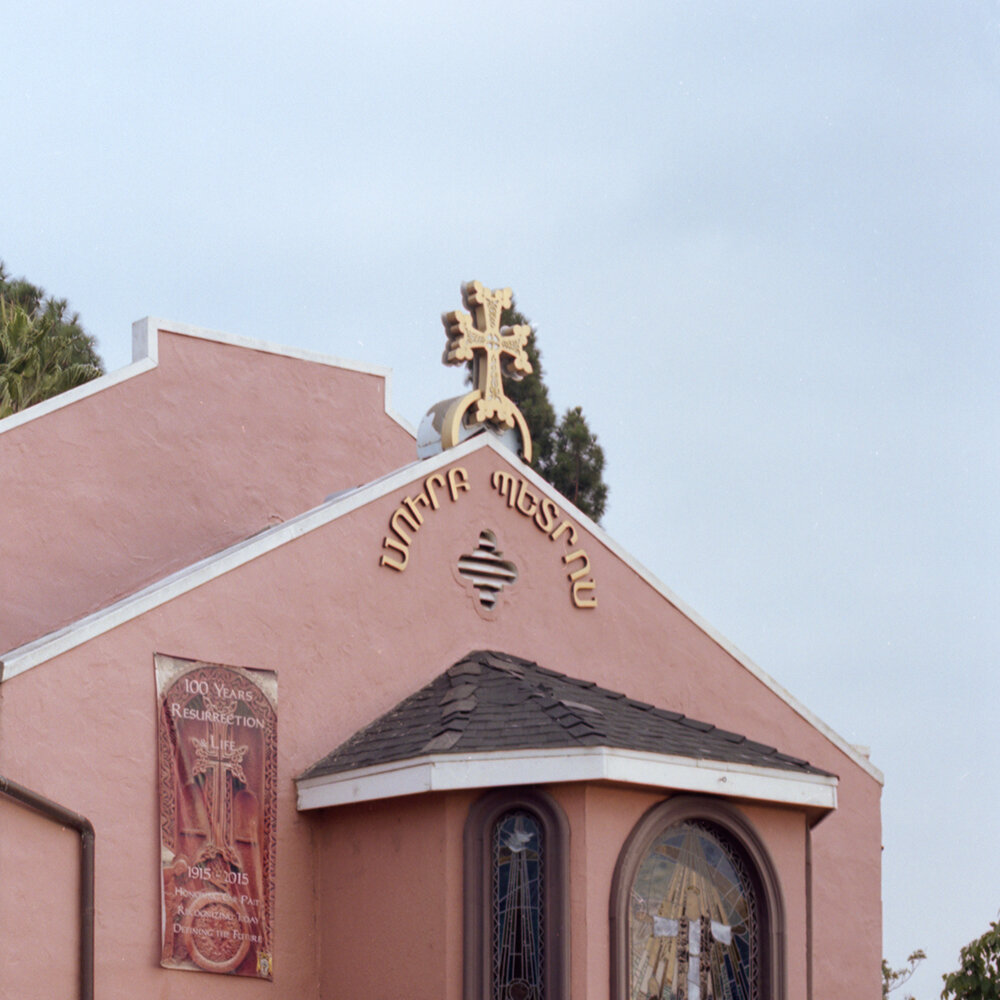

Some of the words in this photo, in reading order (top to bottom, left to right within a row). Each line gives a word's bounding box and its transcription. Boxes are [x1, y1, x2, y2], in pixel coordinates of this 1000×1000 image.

[379, 466, 470, 572] ՍՈՒՐԲ
[491, 469, 598, 609] ՊԵՏՐՈՍ
[184, 678, 209, 696] 100
[213, 682, 253, 702] YEARS
[171, 703, 265, 729] RESURRECTION
[210, 735, 236, 752] LIFE
[187, 866, 211, 880] 1915
[224, 871, 249, 885] 2015
